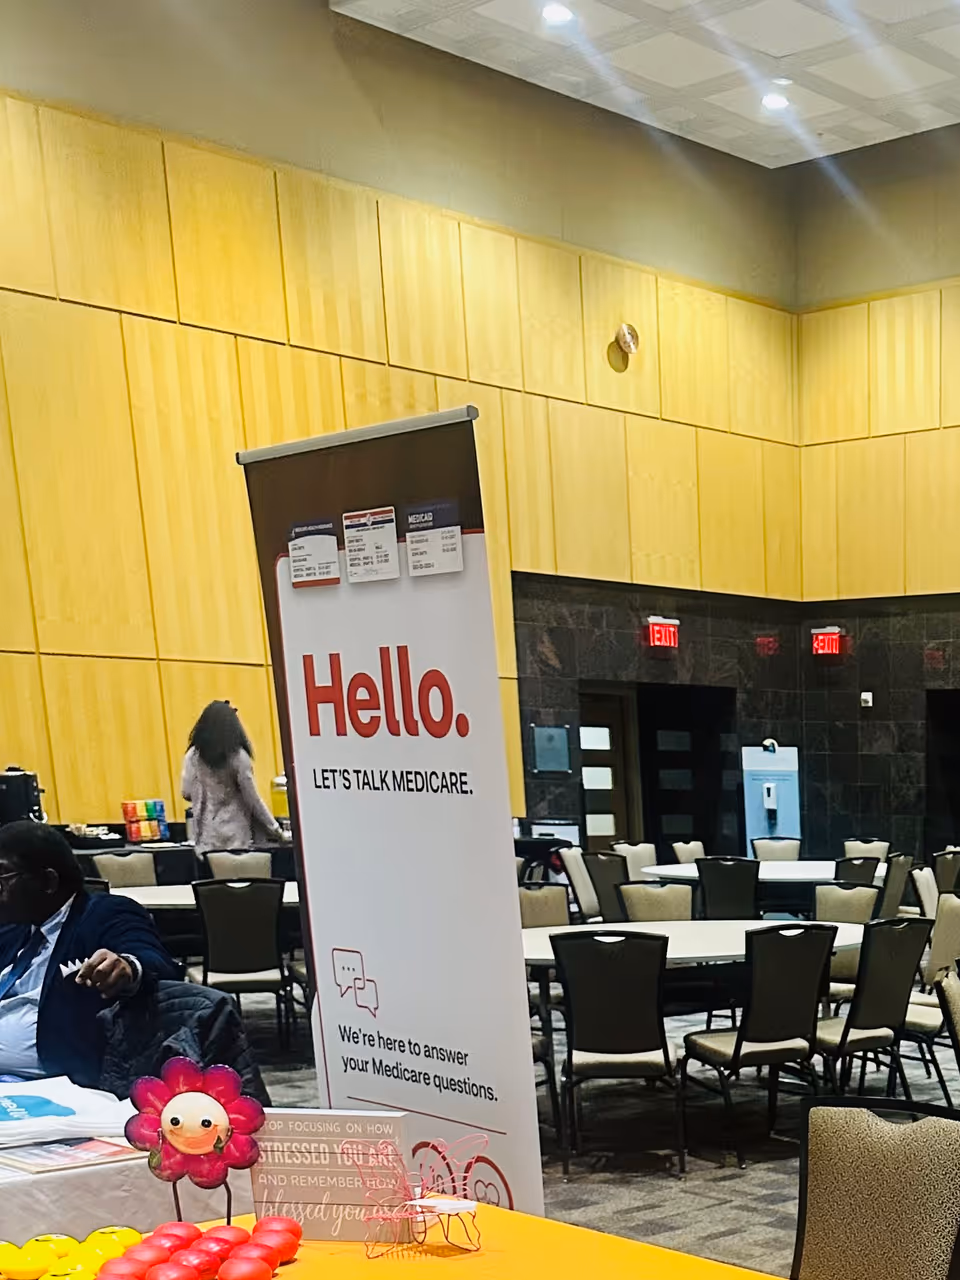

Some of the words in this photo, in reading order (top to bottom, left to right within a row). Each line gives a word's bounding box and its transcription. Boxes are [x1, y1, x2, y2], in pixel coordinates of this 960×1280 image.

[654, 626, 675, 646] EXIT
[818, 635, 839, 653] EXIT
[303, 645, 470, 738] Hello.
[313, 768, 351, 790] LET'S
[353, 770, 391, 790] TALK
[393, 771, 473, 795] MEDICARE.
[339, 1024, 375, 1048] We're
[378, 1032, 405, 1053] here
[408, 1039, 421, 1056] to
[424, 1044, 469, 1067] answer
[342, 1055, 368, 1073] your
[372, 1057, 430, 1085] Medicare
[433, 1074, 498, 1102] questions.
[289, 1122, 340, 1132] FOCUSING
[346, 1123, 361, 1133] ON
[367, 1124, 393, 1134] HOW
[258, 1142, 329, 1164] STRESSED
[333, 1144, 362, 1165] YOU
[259, 1174, 286, 1185] AND
[291, 1176, 362, 1188] REMEMBER
[261, 1189, 330, 1225] blessed
[332, 1204, 366, 1236] you
